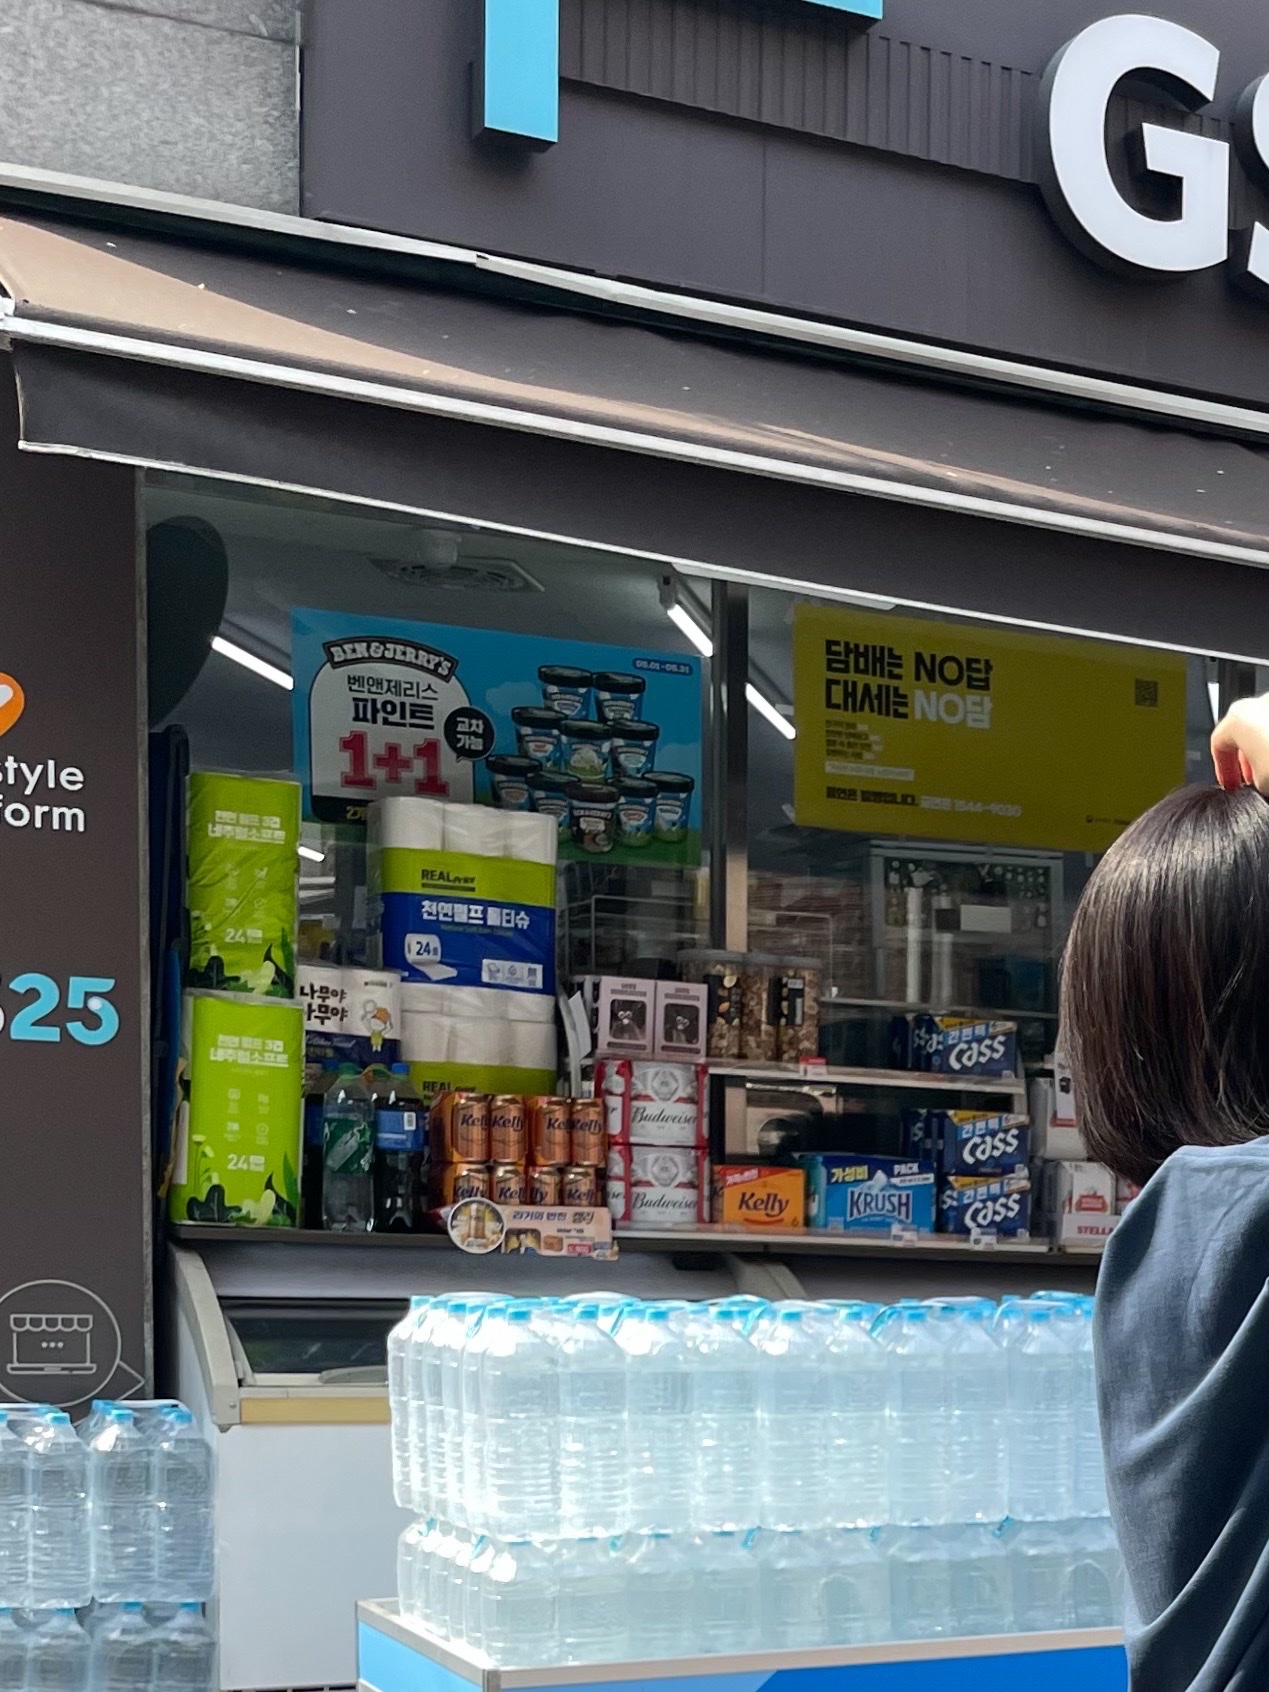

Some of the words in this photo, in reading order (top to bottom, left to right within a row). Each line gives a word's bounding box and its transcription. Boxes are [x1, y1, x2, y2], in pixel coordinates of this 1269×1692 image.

[825, 639, 903, 681] 담배는
[913, 651, 993, 692] NO담
[347, 675, 439, 701] 벤앤제리스
[825, 678, 909, 720] 대세는
[352, 697, 435, 730] 파인트
[456, 717, 484, 734] 교차
[456, 734, 484, 751] 가능
[339, 730, 450, 796] 1+1
[421, 868, 451, 882] REAL
[299, 982, 348, 1004] 나무야
[948, 1034, 1006, 1071] Cass
[962, 1127, 1019, 1165] Cass
[893, 1163, 919, 1176] PACK
[738, 1192, 789, 1218] Kelly
[849, 1190, 911, 1221] KRUSH
[964, 1193, 1021, 1229] Cass
